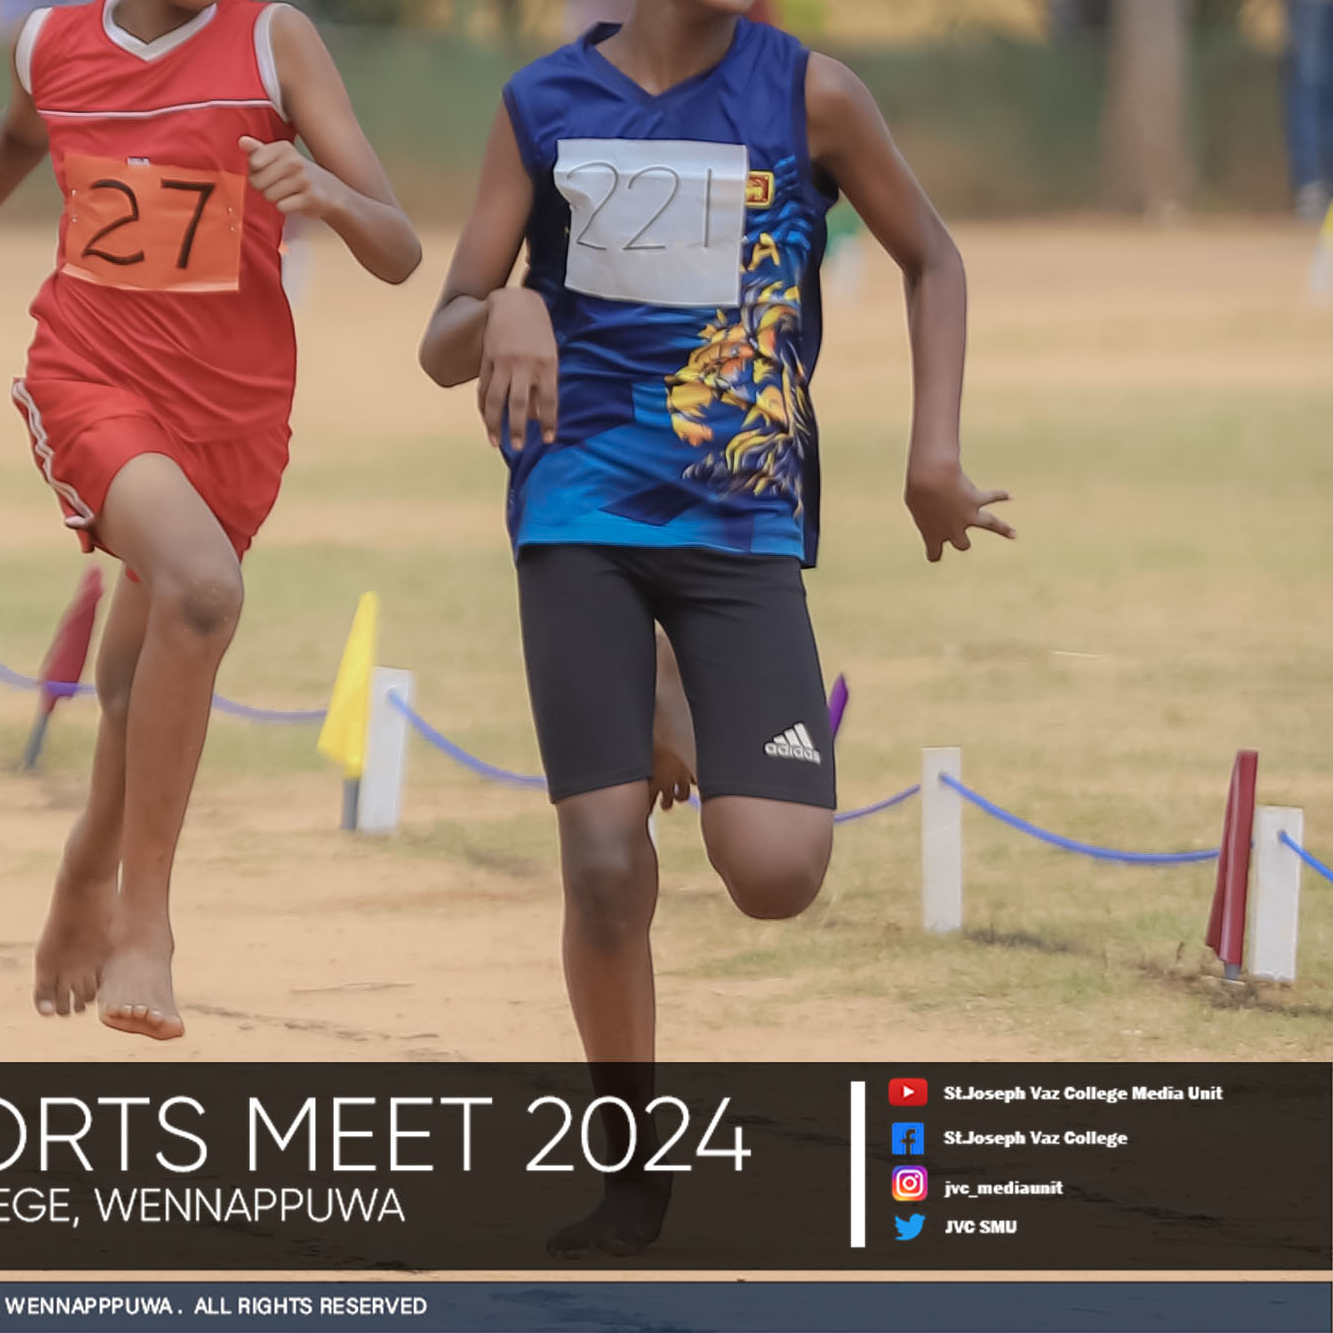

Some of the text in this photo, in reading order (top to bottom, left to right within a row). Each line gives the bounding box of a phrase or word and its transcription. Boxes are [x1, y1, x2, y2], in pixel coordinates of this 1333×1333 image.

[81, 178, 215, 270] 27
[566, 161, 712, 251] 221
[764, 742, 821, 766] adidas
